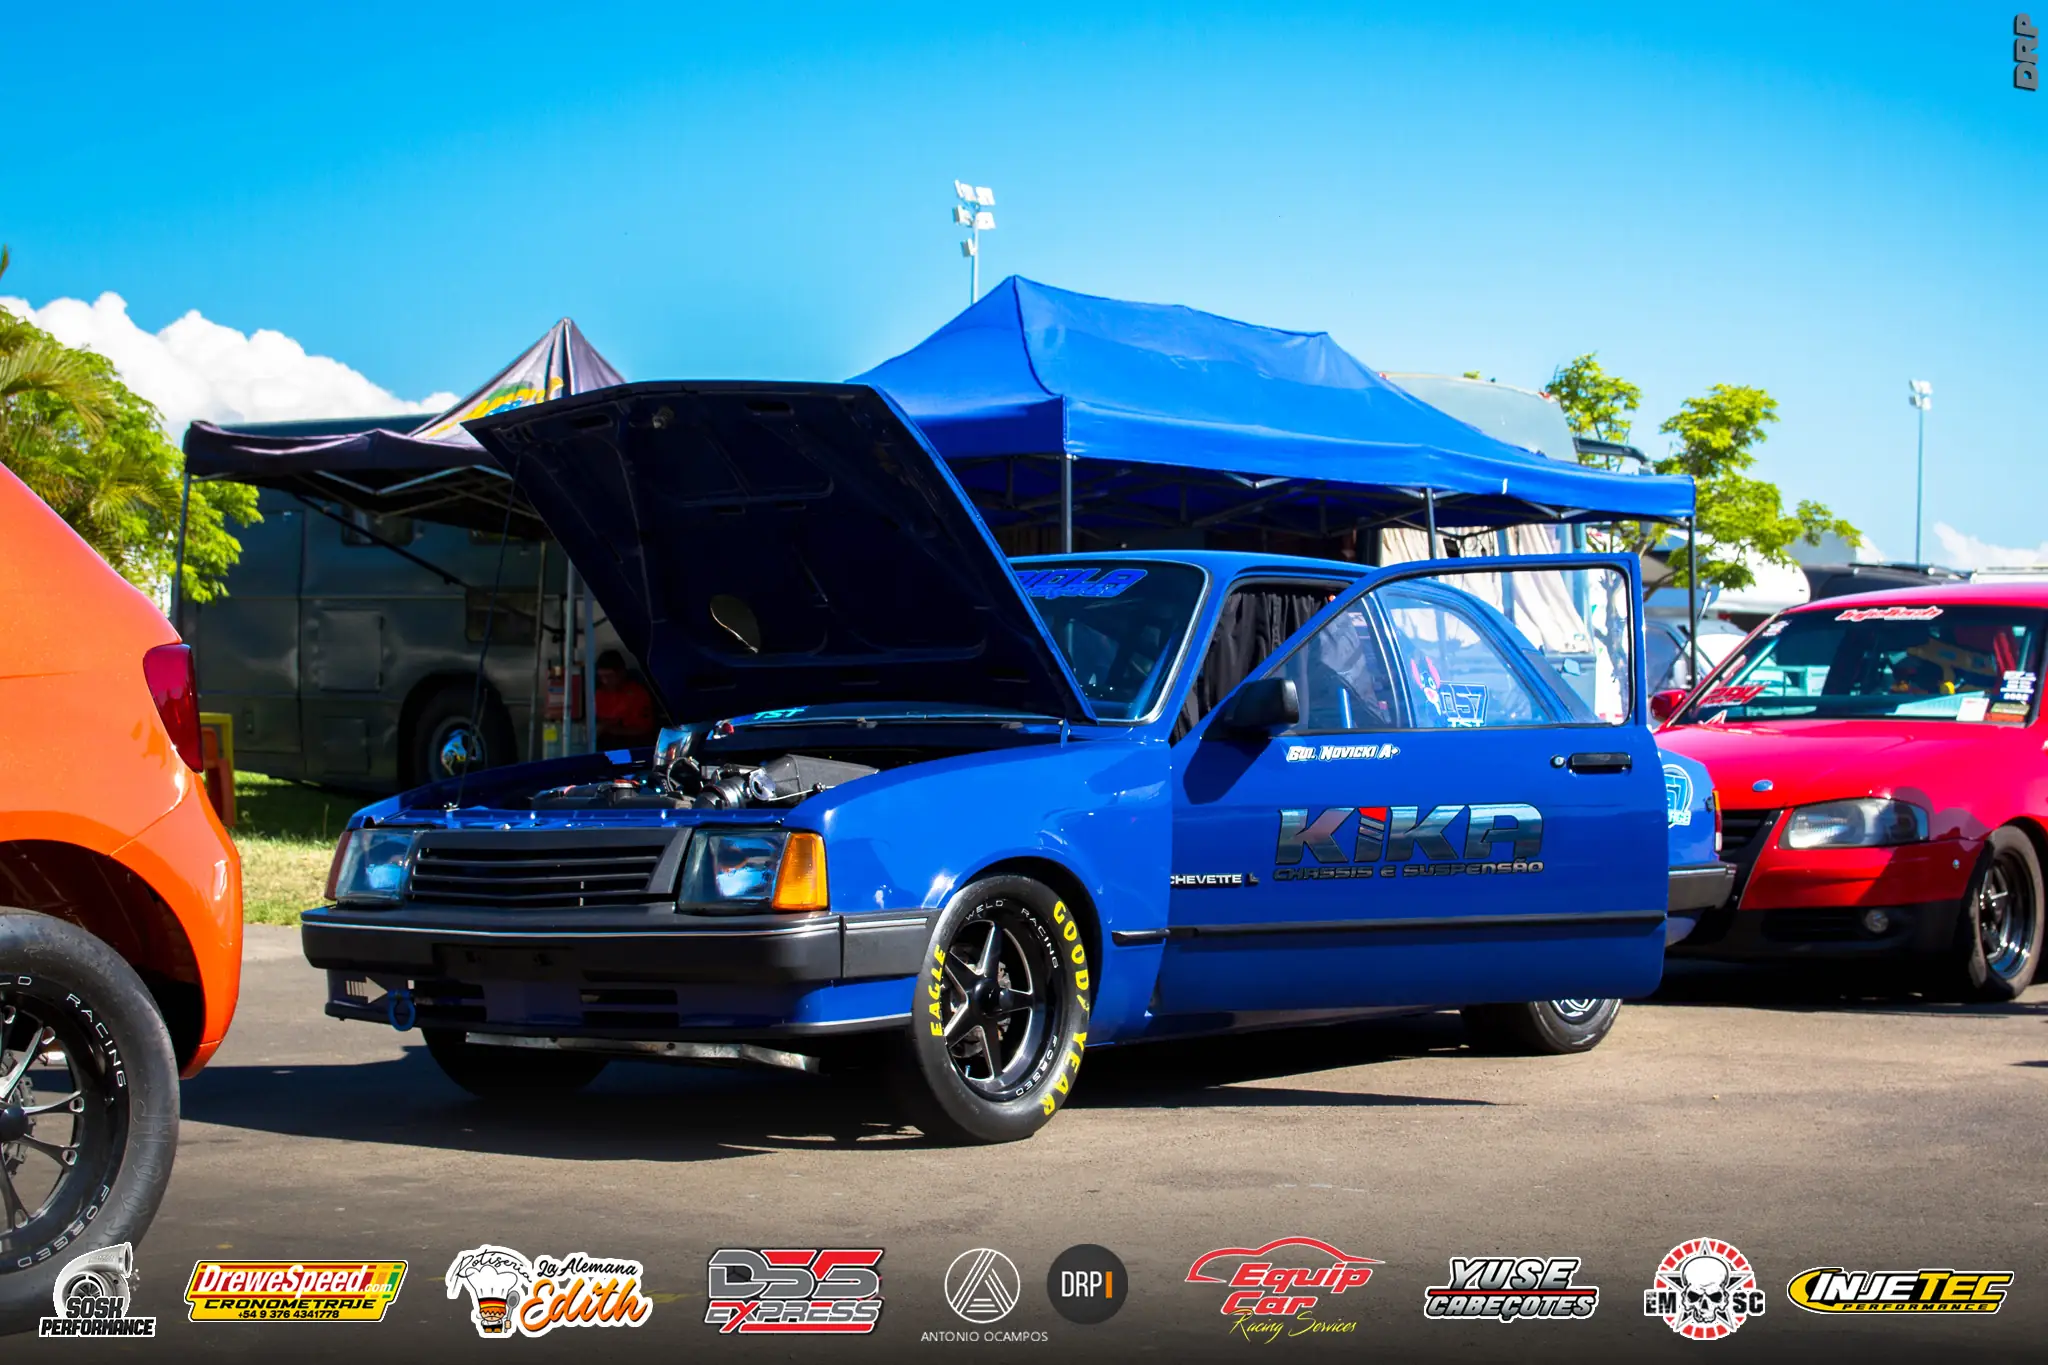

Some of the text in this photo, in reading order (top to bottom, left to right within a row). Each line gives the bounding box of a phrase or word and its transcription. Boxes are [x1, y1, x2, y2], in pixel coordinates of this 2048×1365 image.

[1273, 858, 1544, 881] CHASSIS E SUSPENSÃO
[965, 900, 1059, 969] WELD RACING
[928, 945, 947, 1037] EAGLE
[66, 993, 127, 1088] RACING
[1015, 1034, 1057, 1097] FORGED
[1040, 1031, 1088, 1116] YEAR
[18, 1184, 110, 1269] FORGED
